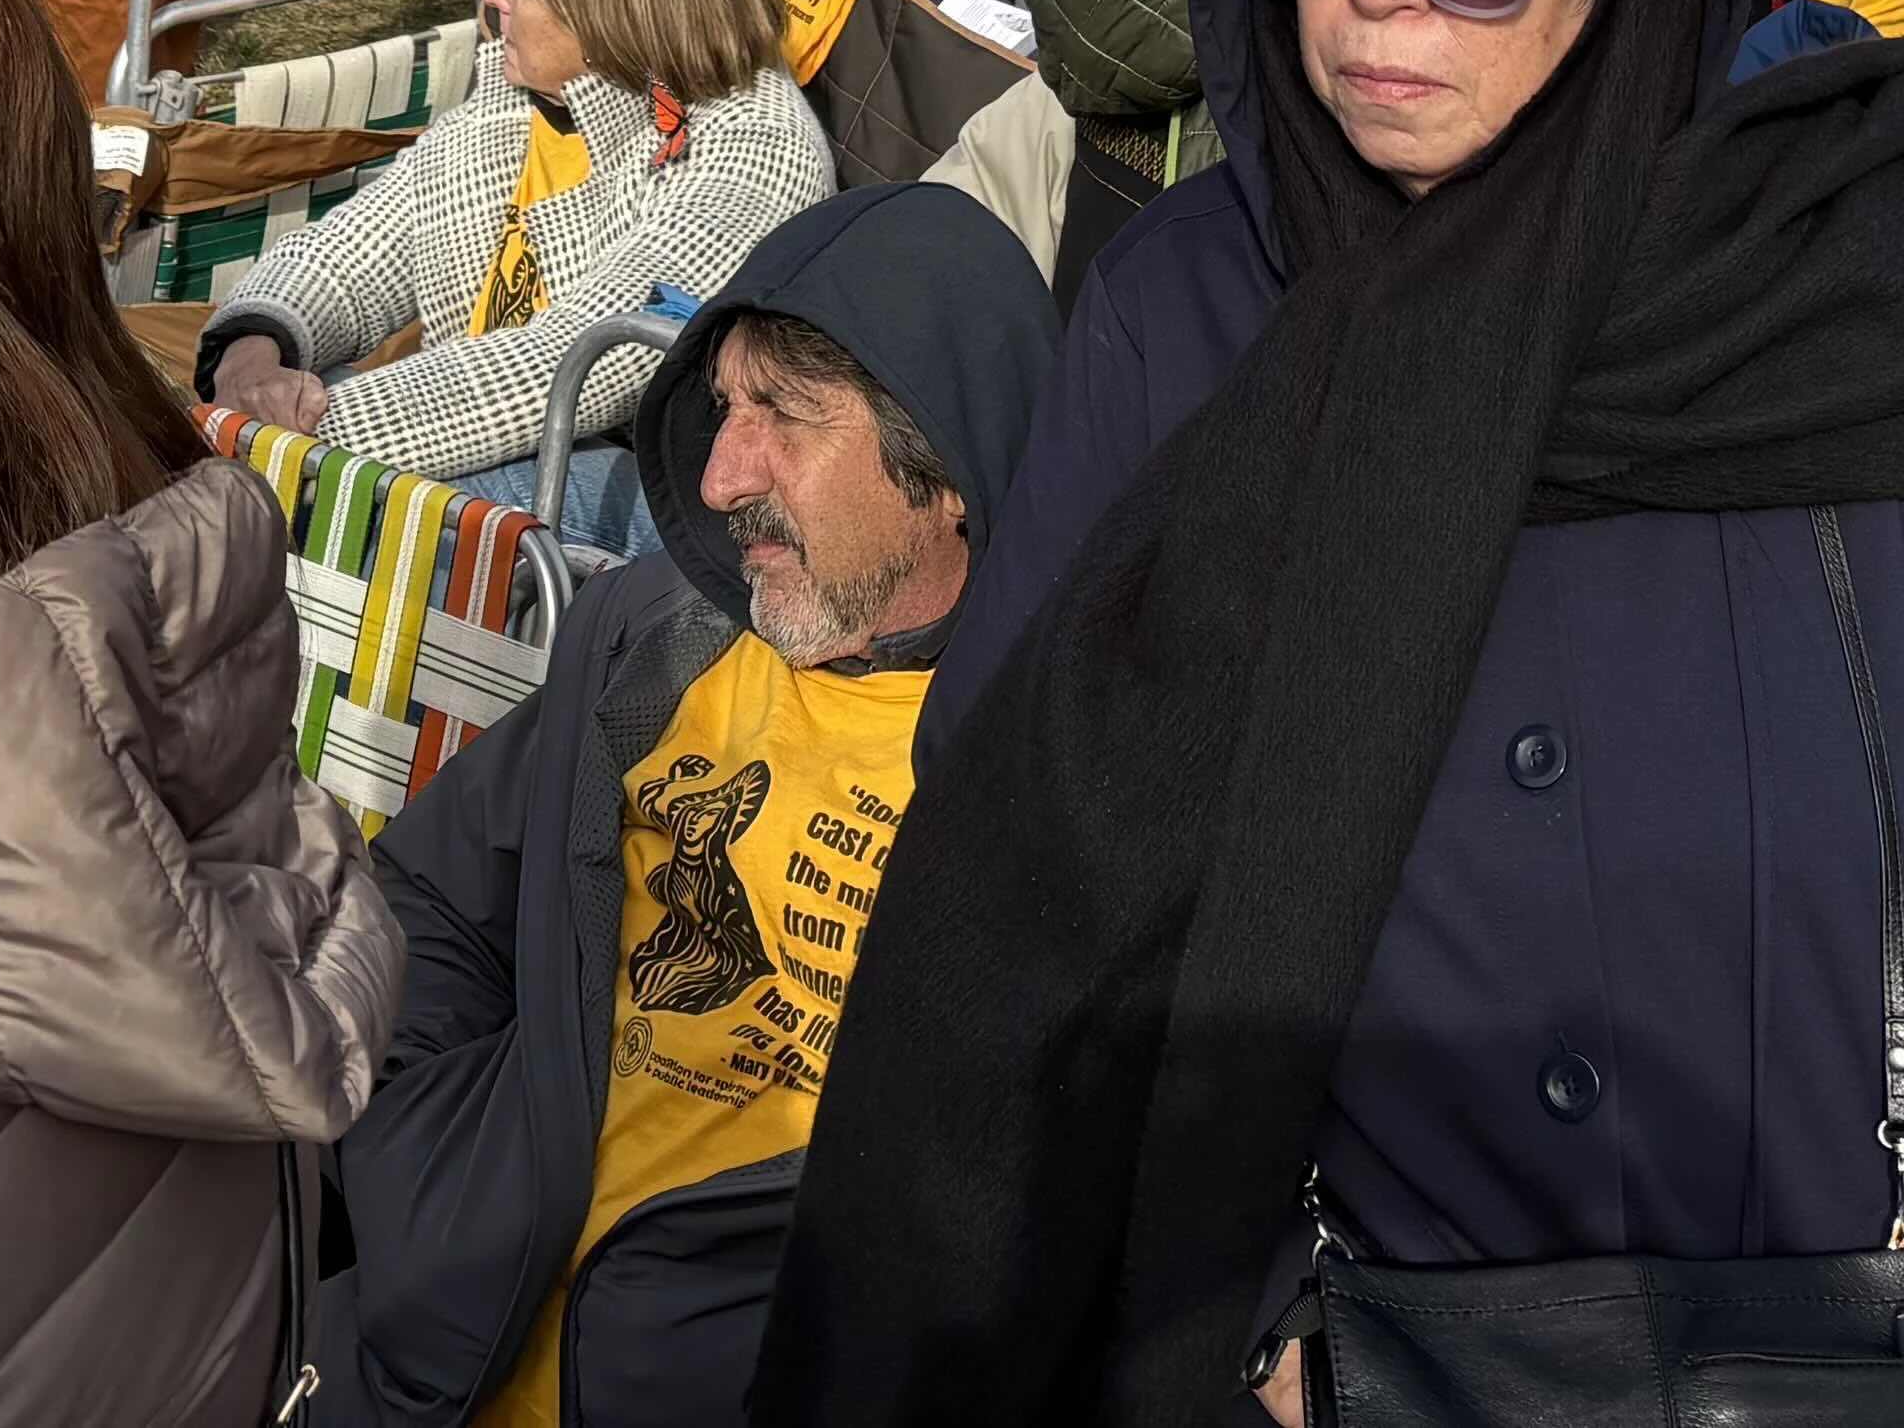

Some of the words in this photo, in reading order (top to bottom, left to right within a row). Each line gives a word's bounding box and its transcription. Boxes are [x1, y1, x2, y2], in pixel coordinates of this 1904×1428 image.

[806, 810, 873, 863] cast
[784, 849, 832, 896] the
[777, 940, 845, 1006] throne
[752, 984, 806, 1034] has
[729, 1051, 771, 1082] Mary
